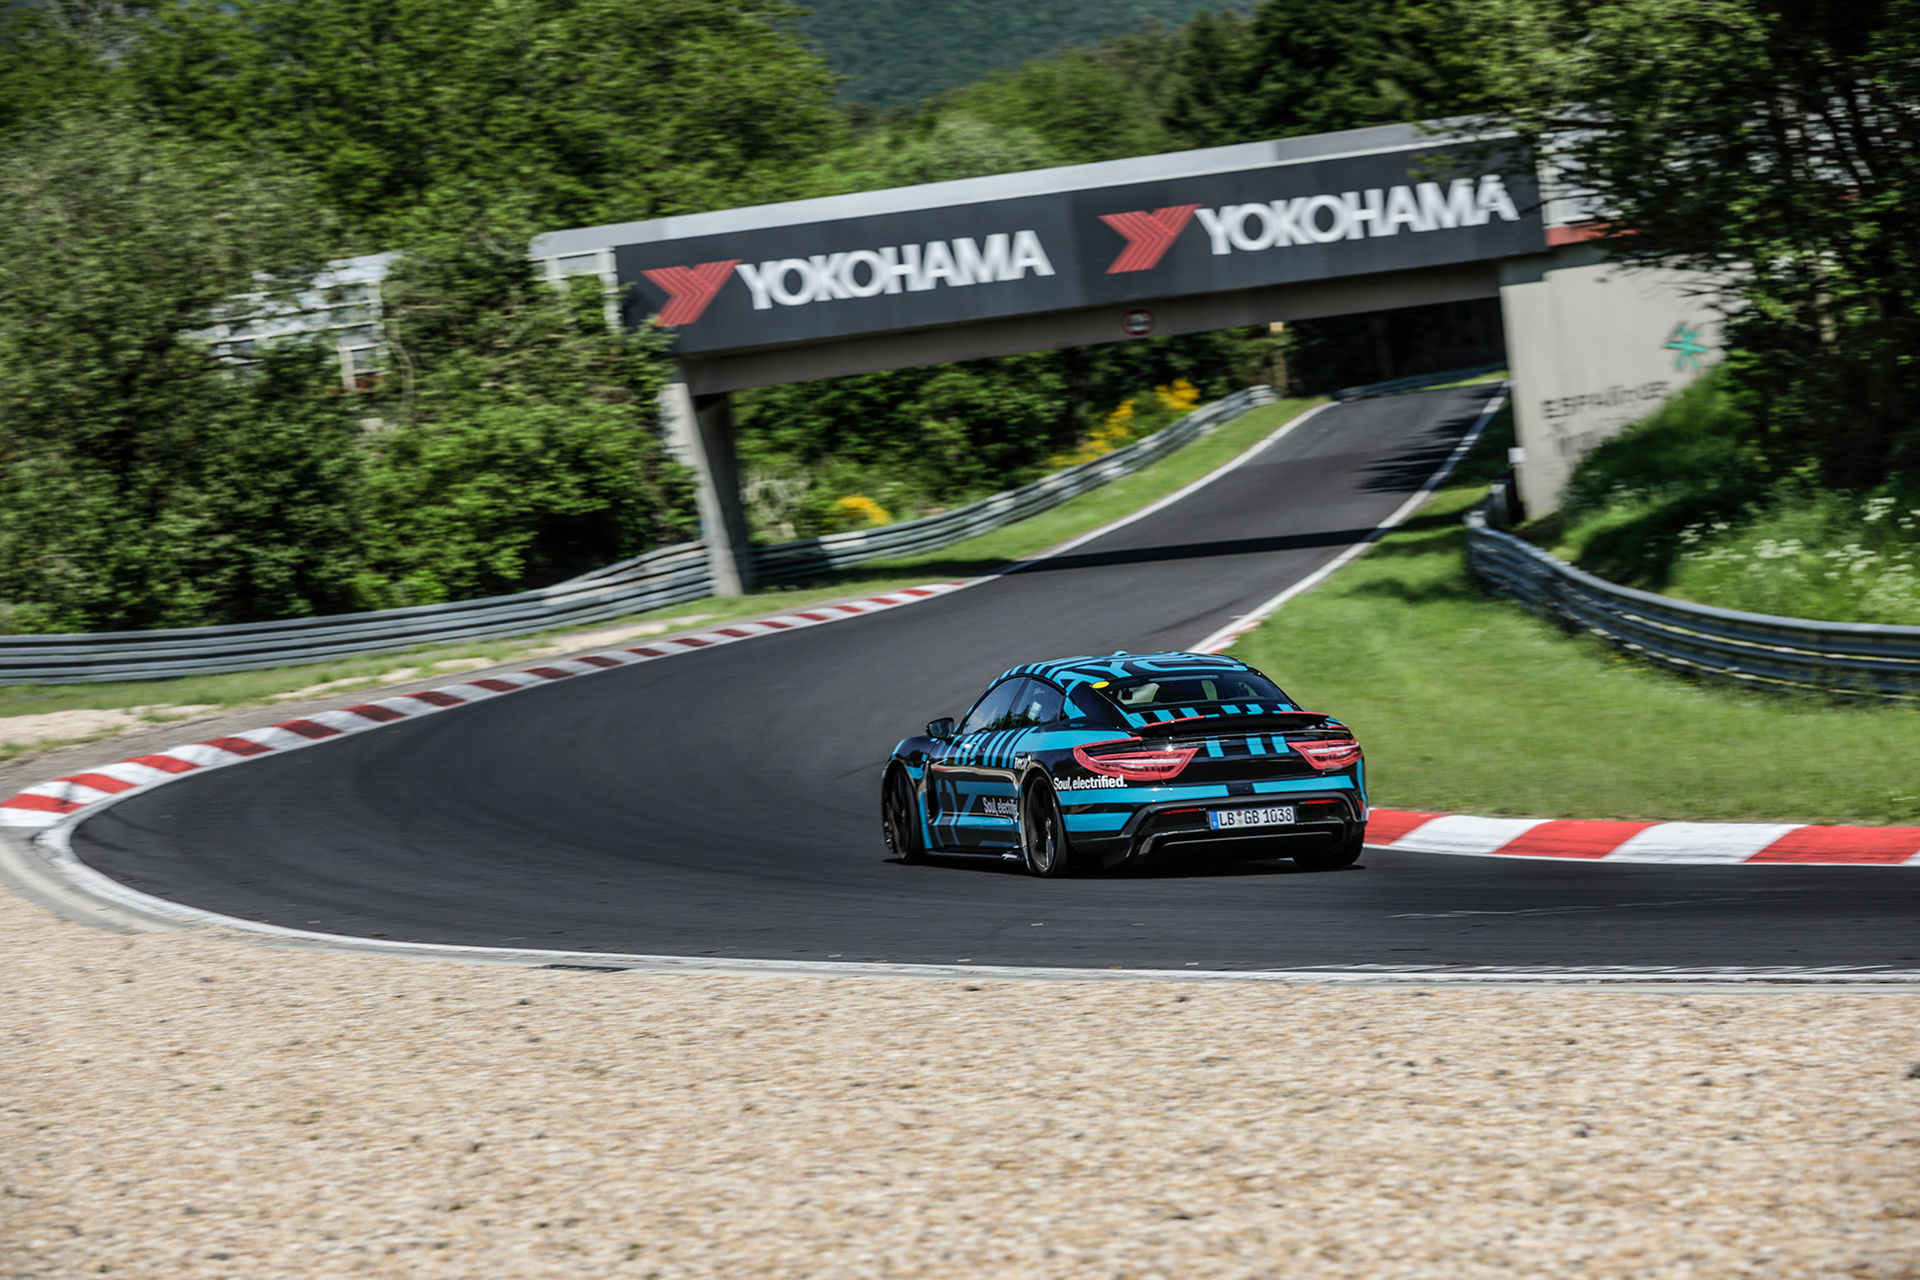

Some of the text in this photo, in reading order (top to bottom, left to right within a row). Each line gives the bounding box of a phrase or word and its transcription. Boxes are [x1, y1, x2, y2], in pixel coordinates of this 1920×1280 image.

[1194, 174, 1520, 256] YOKOHAMA
[734, 229, 1056, 310] YOKOHAMA
[1053, 774, 1128, 791] Soul, electrified.
[1219, 807, 1293, 827] LB GB 1038
